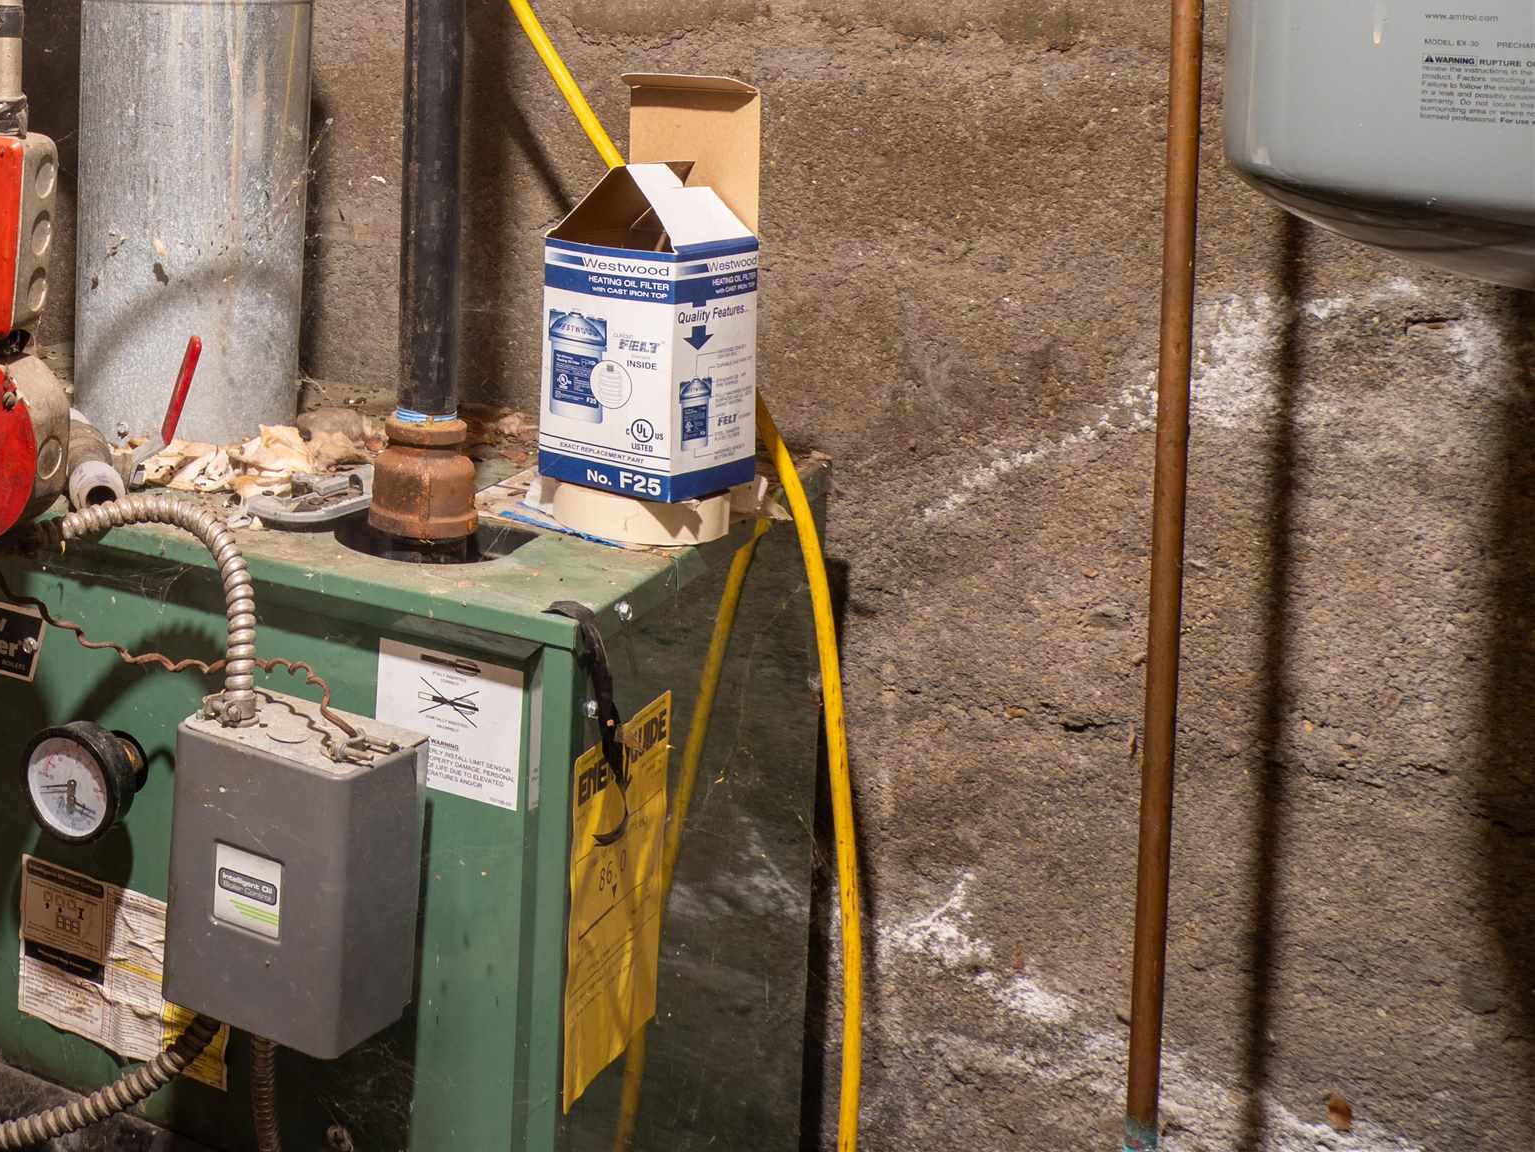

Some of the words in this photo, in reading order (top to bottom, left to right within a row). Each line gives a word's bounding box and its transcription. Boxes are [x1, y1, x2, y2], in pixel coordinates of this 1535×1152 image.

[1434, 55, 1475, 65] WARNING
[1479, 58, 1522, 68] RUPTURE
[582, 256, 670, 276] Westwood
[707, 255, 757, 272] Westwood
[588, 275, 622, 287] HEATING
[624, 279, 638, 288] OIL
[640, 281, 670, 292] FILTER
[608, 287, 628, 295] CAST
[629, 289, 649, 297] IRON
[677, 309, 711, 324] Quality
[618, 338, 660, 354] FELT
[626, 359, 658, 371] INSIDE
[717, 414, 739, 427] FELT
[559, 441, 580, 451] EXACT
[580, 446, 626, 460] REPLACEMENT
[627, 456, 645, 464] PART
[631, 442, 654, 453] LISTED
[586, 468, 612, 486] No.
[619, 470, 661, 497] F25
[431, 738, 459, 750] WARNING
